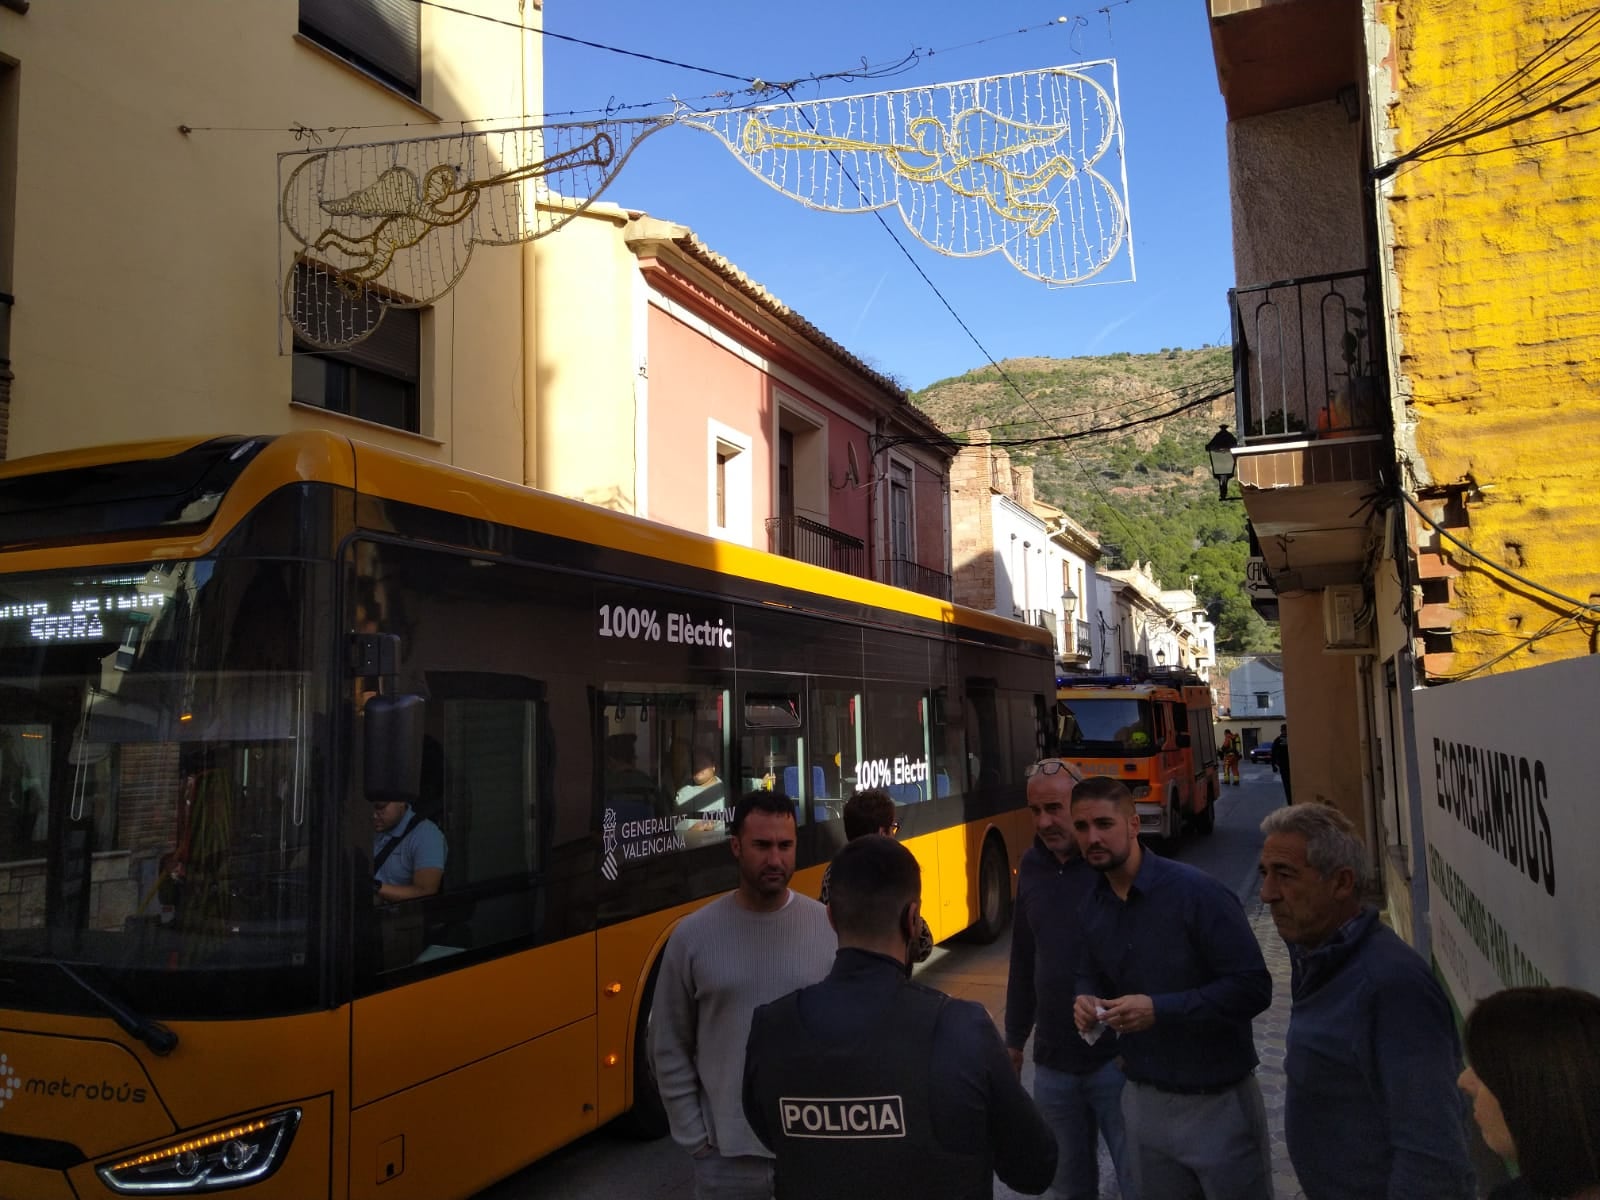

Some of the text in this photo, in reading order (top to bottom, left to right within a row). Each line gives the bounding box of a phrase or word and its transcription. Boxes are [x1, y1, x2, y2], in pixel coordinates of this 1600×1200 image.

[599, 604, 733, 649] 100% Elèctric
[854, 758, 891, 793] 100%
[621, 813, 688, 839] GENERALITAT
[1433, 737, 1556, 897] ECORECAMBIOS
[622, 834, 686, 860] VALENCIANA
[25, 1076, 147, 1104] metrobús
[783, 1104, 900, 1131] POLICIA
